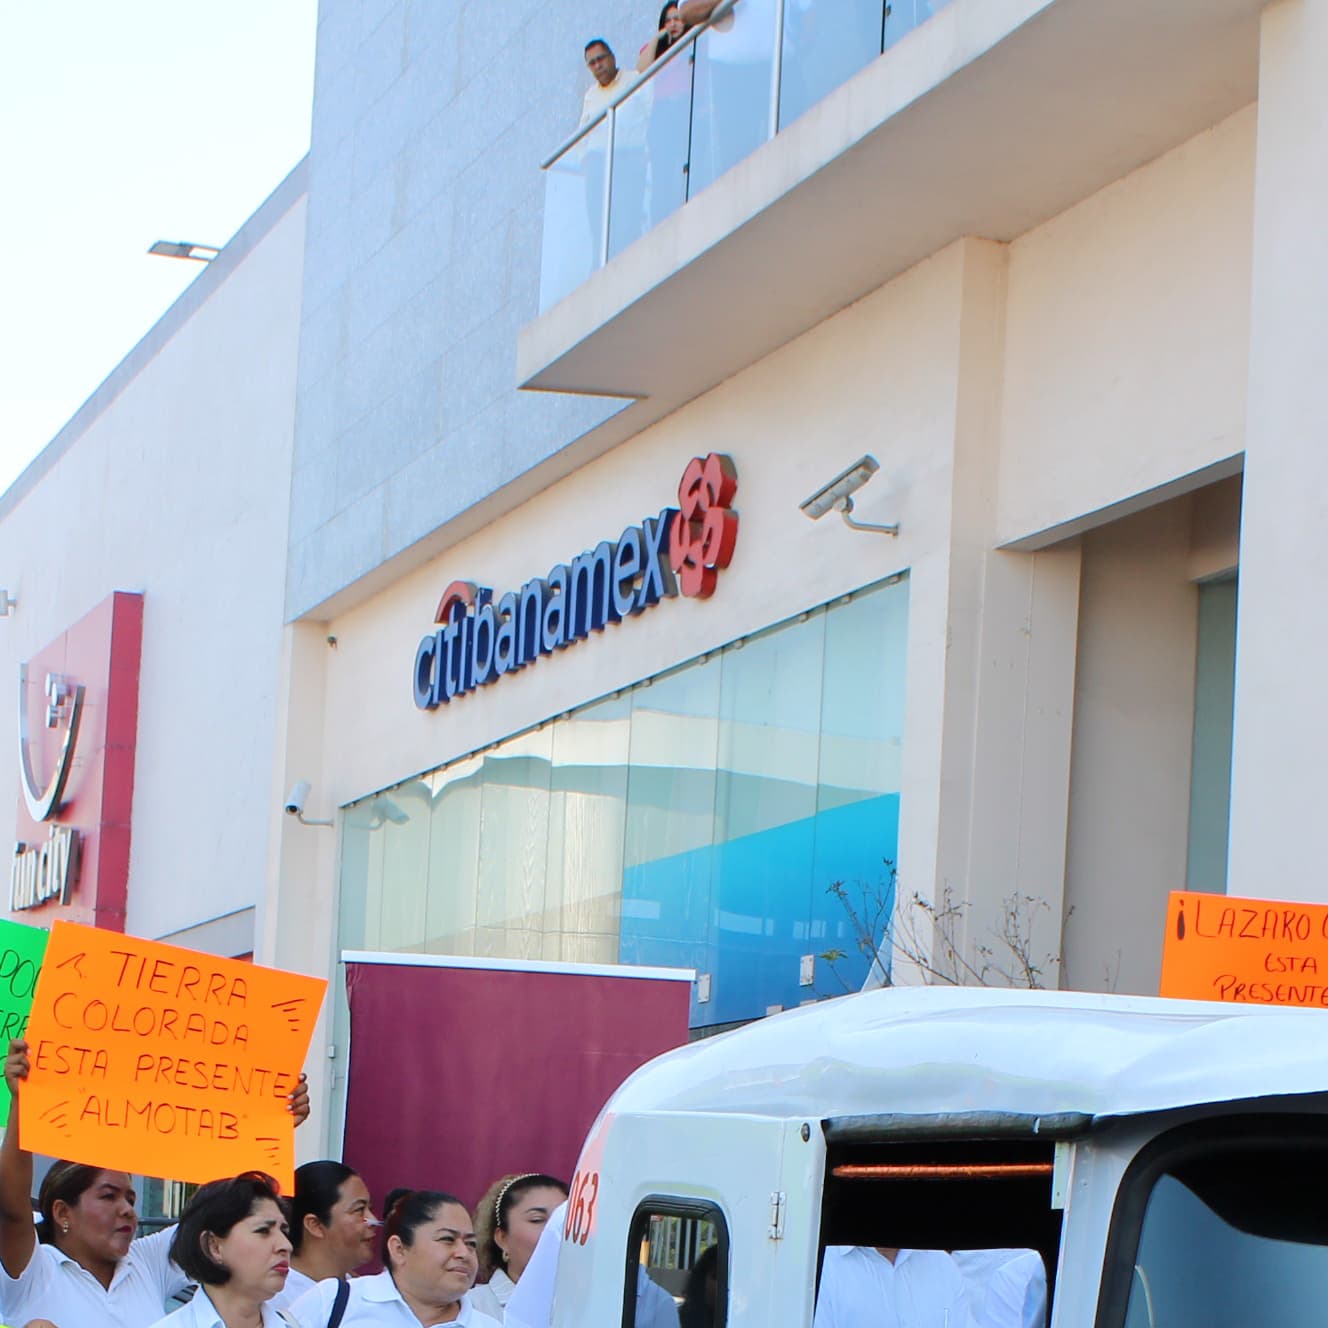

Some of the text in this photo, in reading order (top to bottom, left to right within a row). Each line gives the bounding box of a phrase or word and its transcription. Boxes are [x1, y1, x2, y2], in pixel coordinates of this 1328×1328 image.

[413, 507, 678, 710] citibanamex
[109, 950, 248, 1008] TIERRA
[1264, 952, 1318, 975] ESTA
[52, 992, 249, 1049] COLORADA
[35, 1040, 109, 1080] ESTA
[134, 1054, 292, 1100] PRESENTE
[565, 1170, 599, 1246] 063
